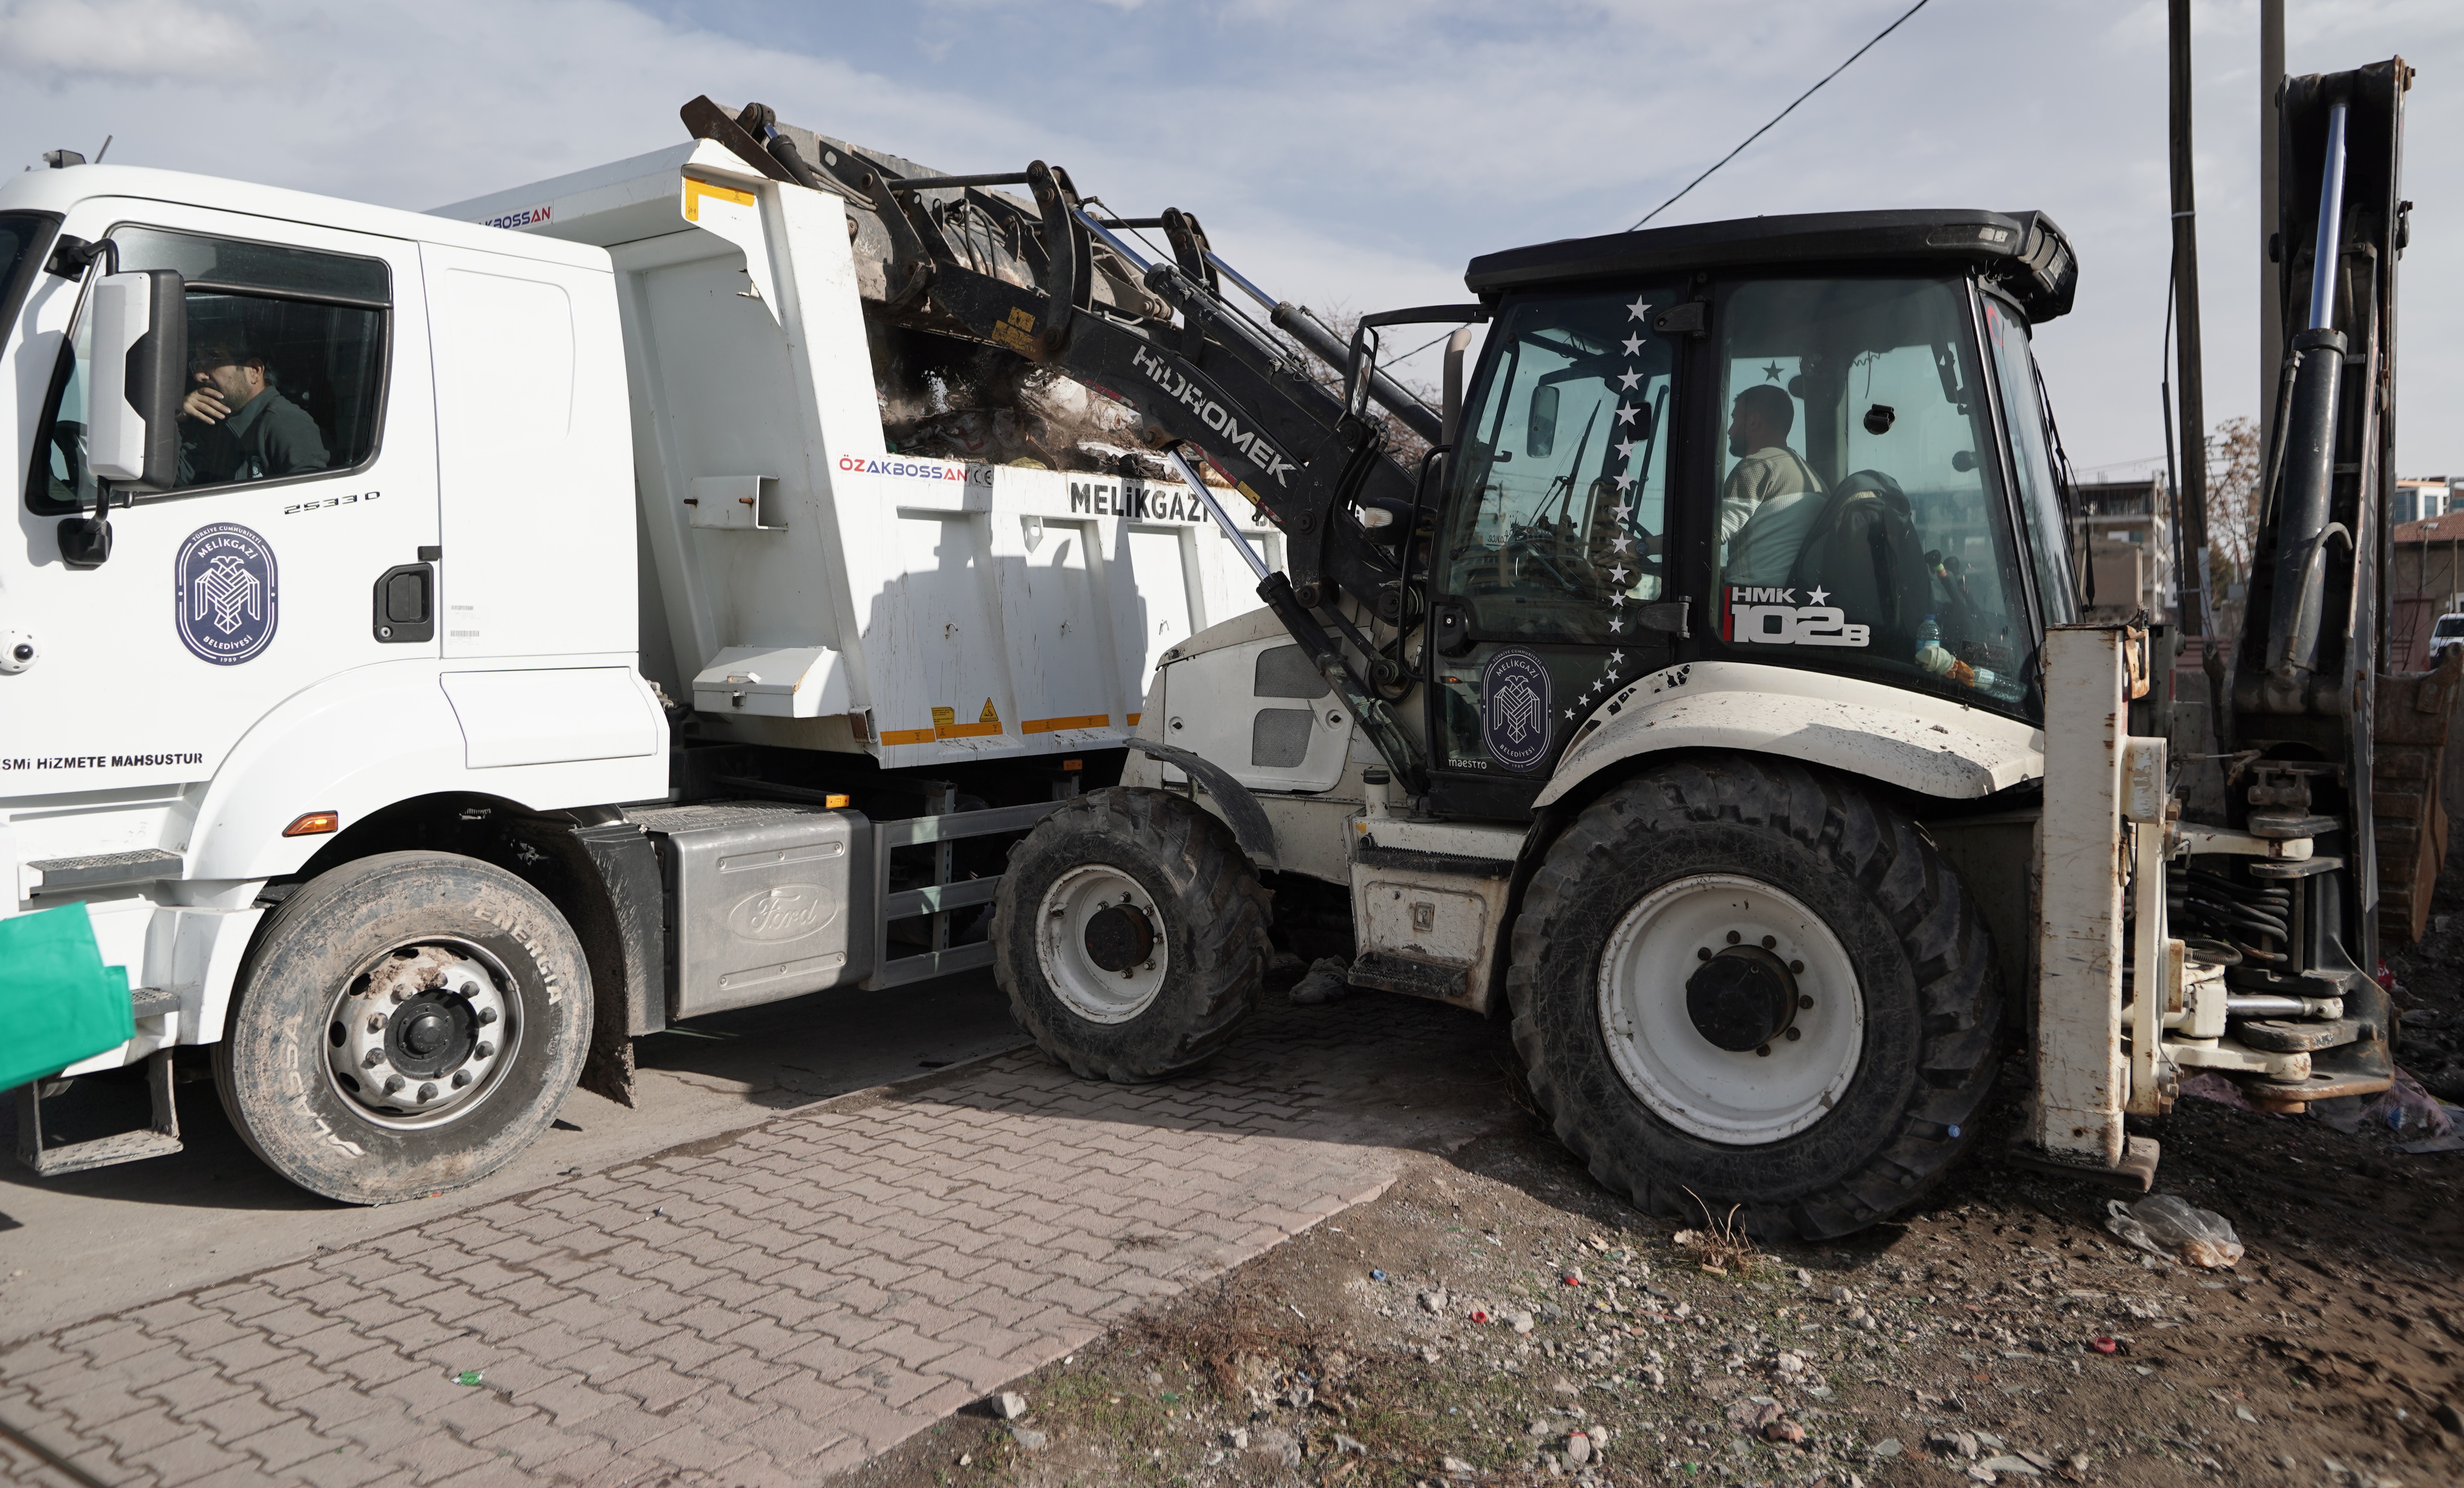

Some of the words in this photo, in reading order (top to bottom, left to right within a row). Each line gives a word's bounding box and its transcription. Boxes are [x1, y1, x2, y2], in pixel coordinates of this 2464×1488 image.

[479, 206, 551, 229] BOSSAN
[839, 454, 967, 482] ÖZAKBOSSAN
[284, 495, 357, 515] 2533
[365, 491, 380, 500] D
[192, 527, 217, 542] TÜRKİYE
[219, 526, 262, 544] CUMHURİYETİ
[198, 537, 258, 559] MELİKGAZİ
[1732, 587, 1796, 603] HMK
[1731, 604, 1870, 647] 102B
[203, 635, 253, 650] BELEDİYESİ
[1492, 650, 1510, 662] TÜRKİYE
[1511, 649, 1542, 665] CUMHURİYETİ
[1496, 659, 1539, 678] MELİKGAZİ
[111, 753, 203, 767] MAHSUSTUR
[1500, 744, 1535, 757] BELEDİYESİ
[1448, 759, 1487, 769] maestro
[752, 894, 818, 933] Ford
[474, 906, 563, 1005] ENERGIA
